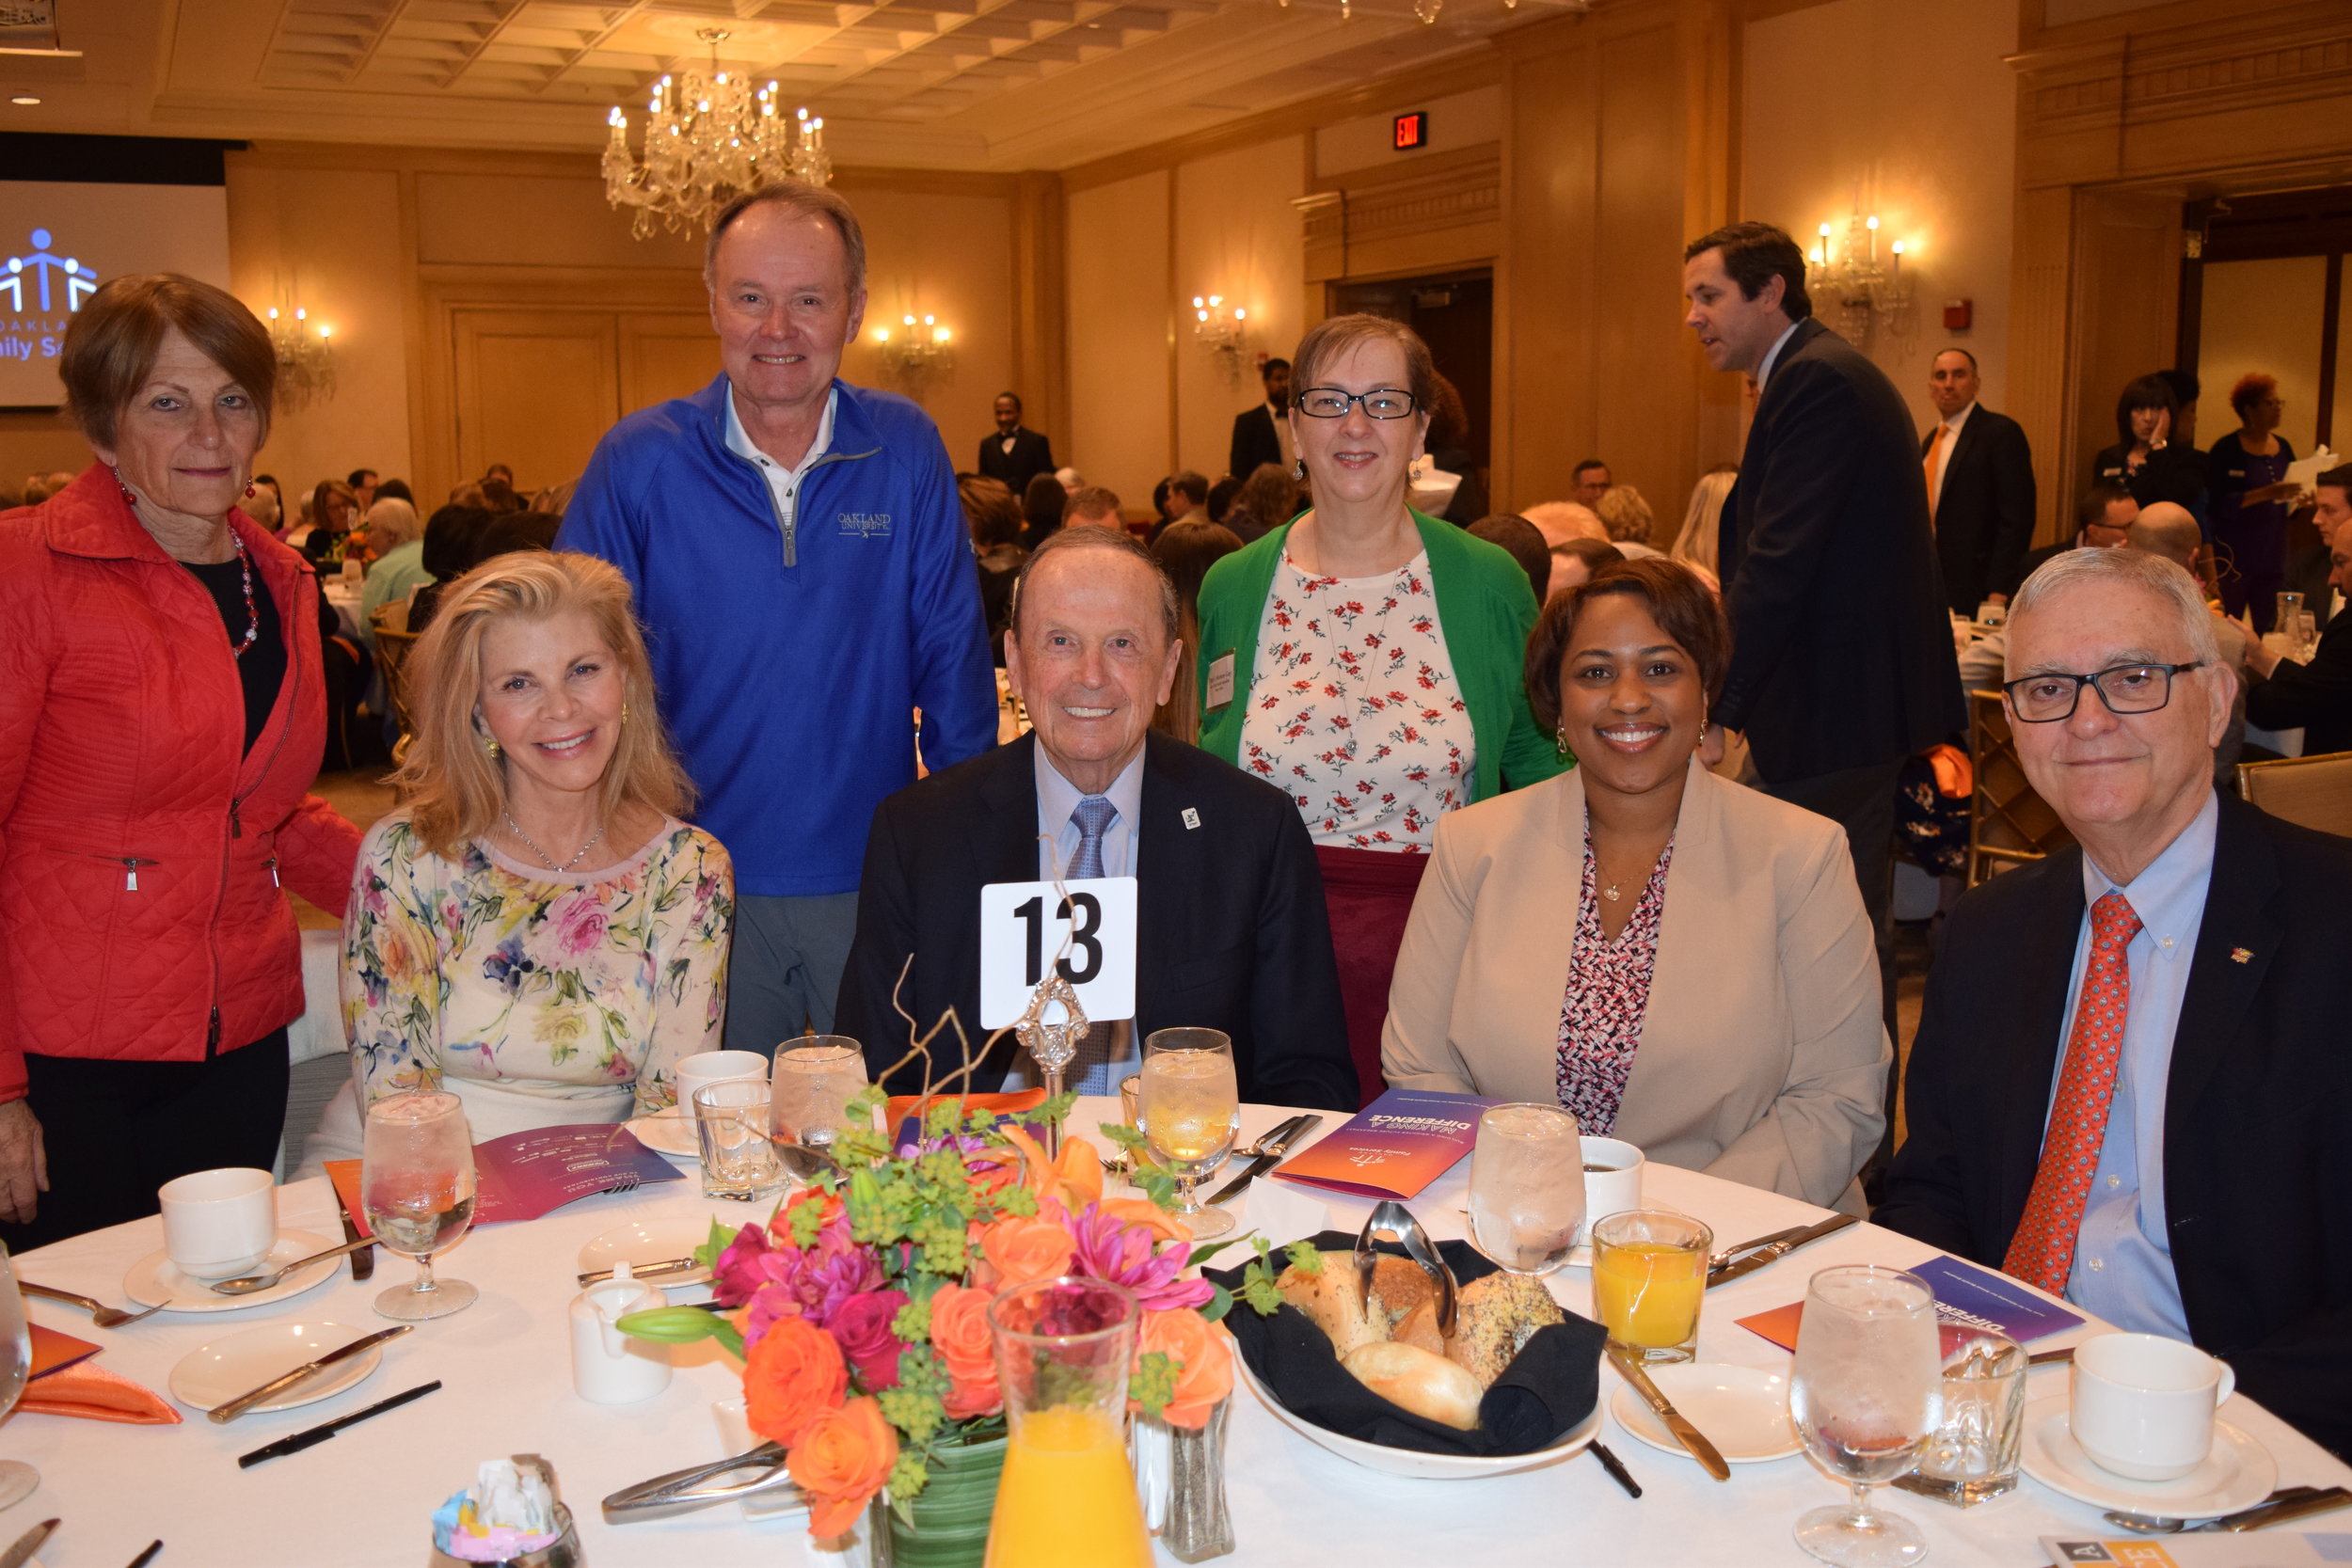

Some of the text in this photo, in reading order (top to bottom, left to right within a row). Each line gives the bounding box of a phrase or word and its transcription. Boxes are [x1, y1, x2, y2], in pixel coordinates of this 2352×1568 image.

[1397, 115, 1418, 147] EXIT
[0, 336, 32, 361] ily
[837, 513, 891, 524] OAKLAND
[841, 522, 888, 531] UNIVERSITY
[1013, 892, 1104, 987] 13
[1369, 1115, 1471, 1131] DIFFERENCE
[1386, 1122, 1457, 1135] MAKING
[566, 1182, 595, 1194] YOU
